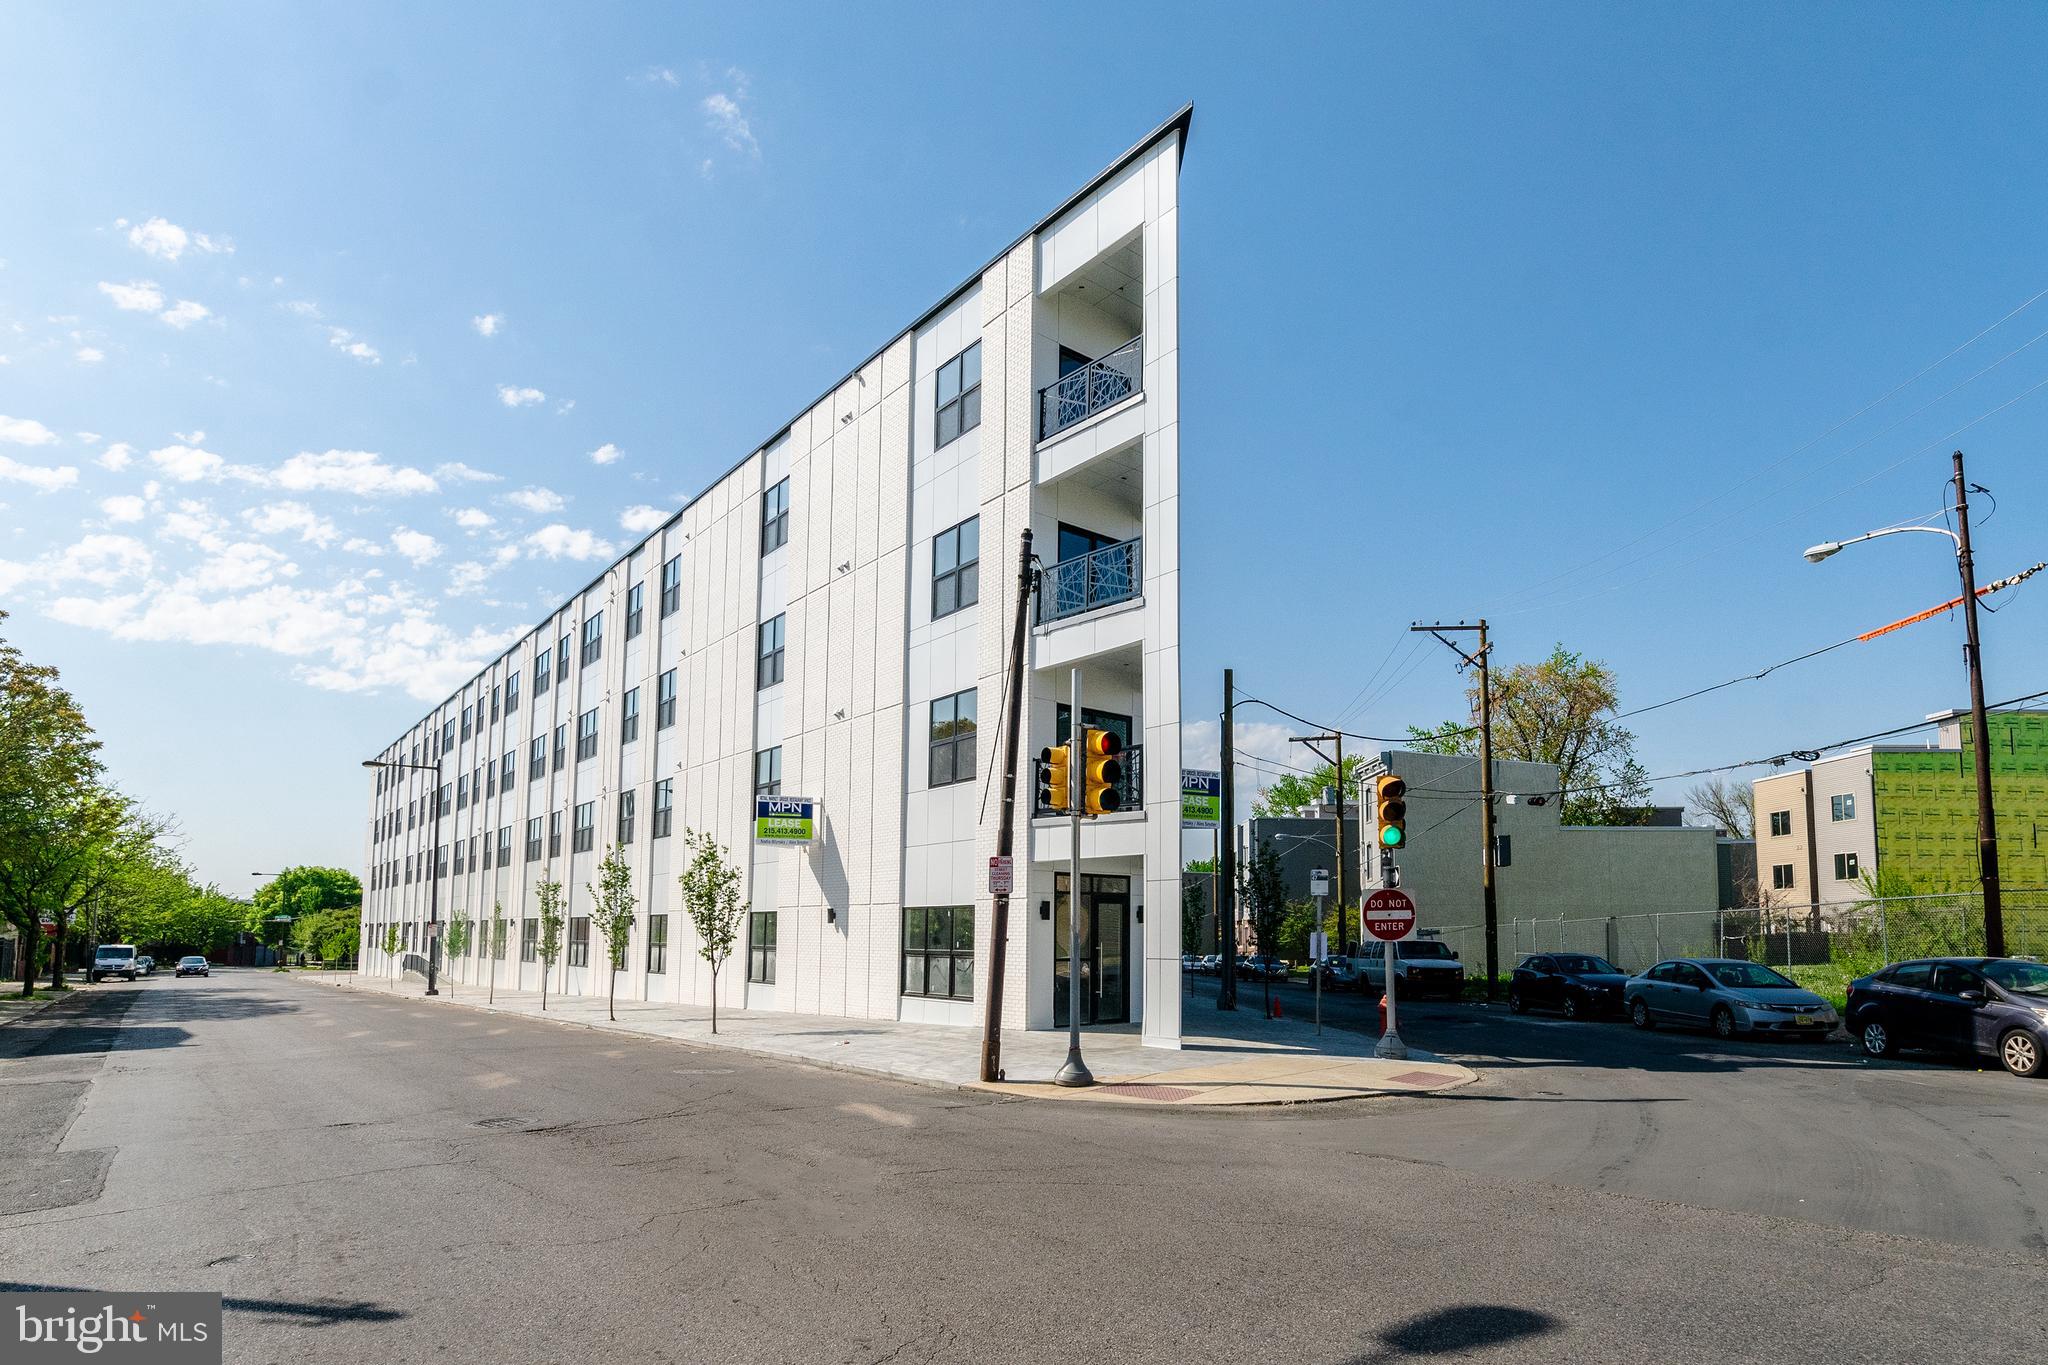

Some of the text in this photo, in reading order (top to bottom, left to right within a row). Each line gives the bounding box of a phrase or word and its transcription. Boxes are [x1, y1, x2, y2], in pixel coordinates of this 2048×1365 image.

[768, 802, 802, 813] MPN
[768, 818, 801, 828] LEASE
[1370, 899, 1407, 908] DO NOT
[1374, 922, 1405, 931] ENTER
